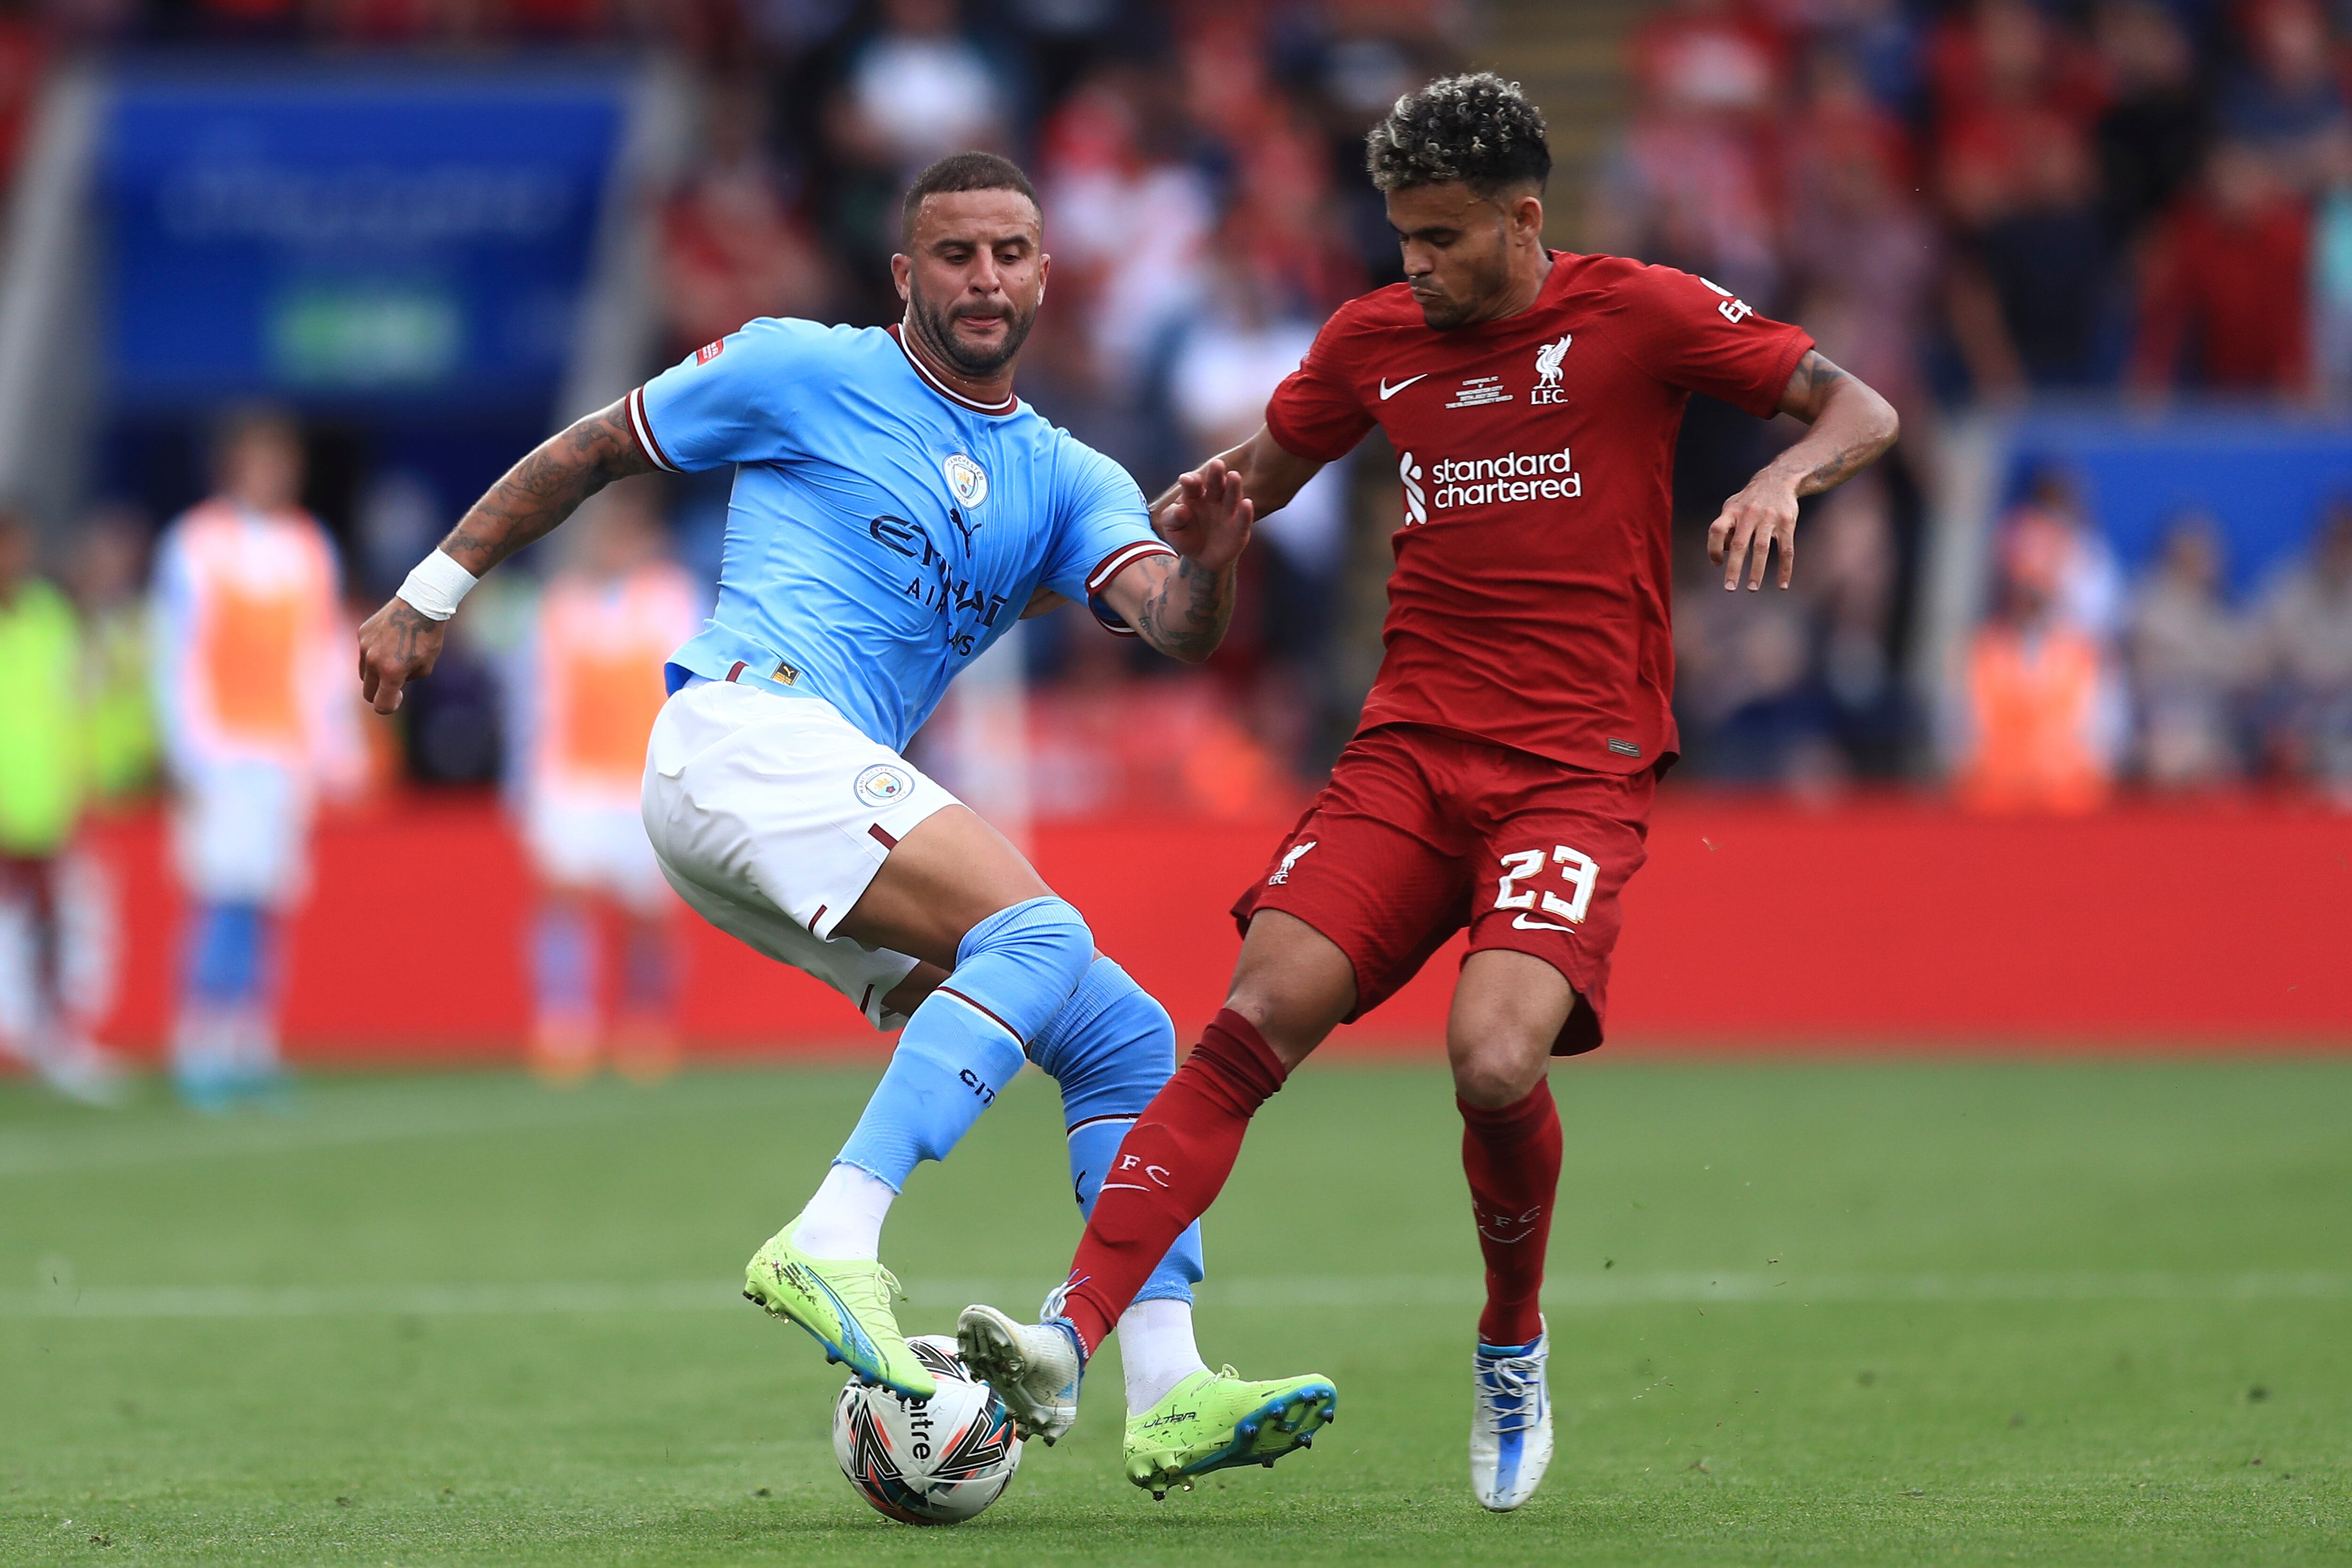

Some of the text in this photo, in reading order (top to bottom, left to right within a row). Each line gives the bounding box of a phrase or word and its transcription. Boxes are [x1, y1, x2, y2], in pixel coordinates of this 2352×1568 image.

[1432, 448, 1571, 484] standard
[1434, 472, 1581, 509] chartered
[1493, 845, 1600, 924] 23
[959, 1068, 996, 1105] CIT
[1144, 1412, 1196, 1428] ULTRA
